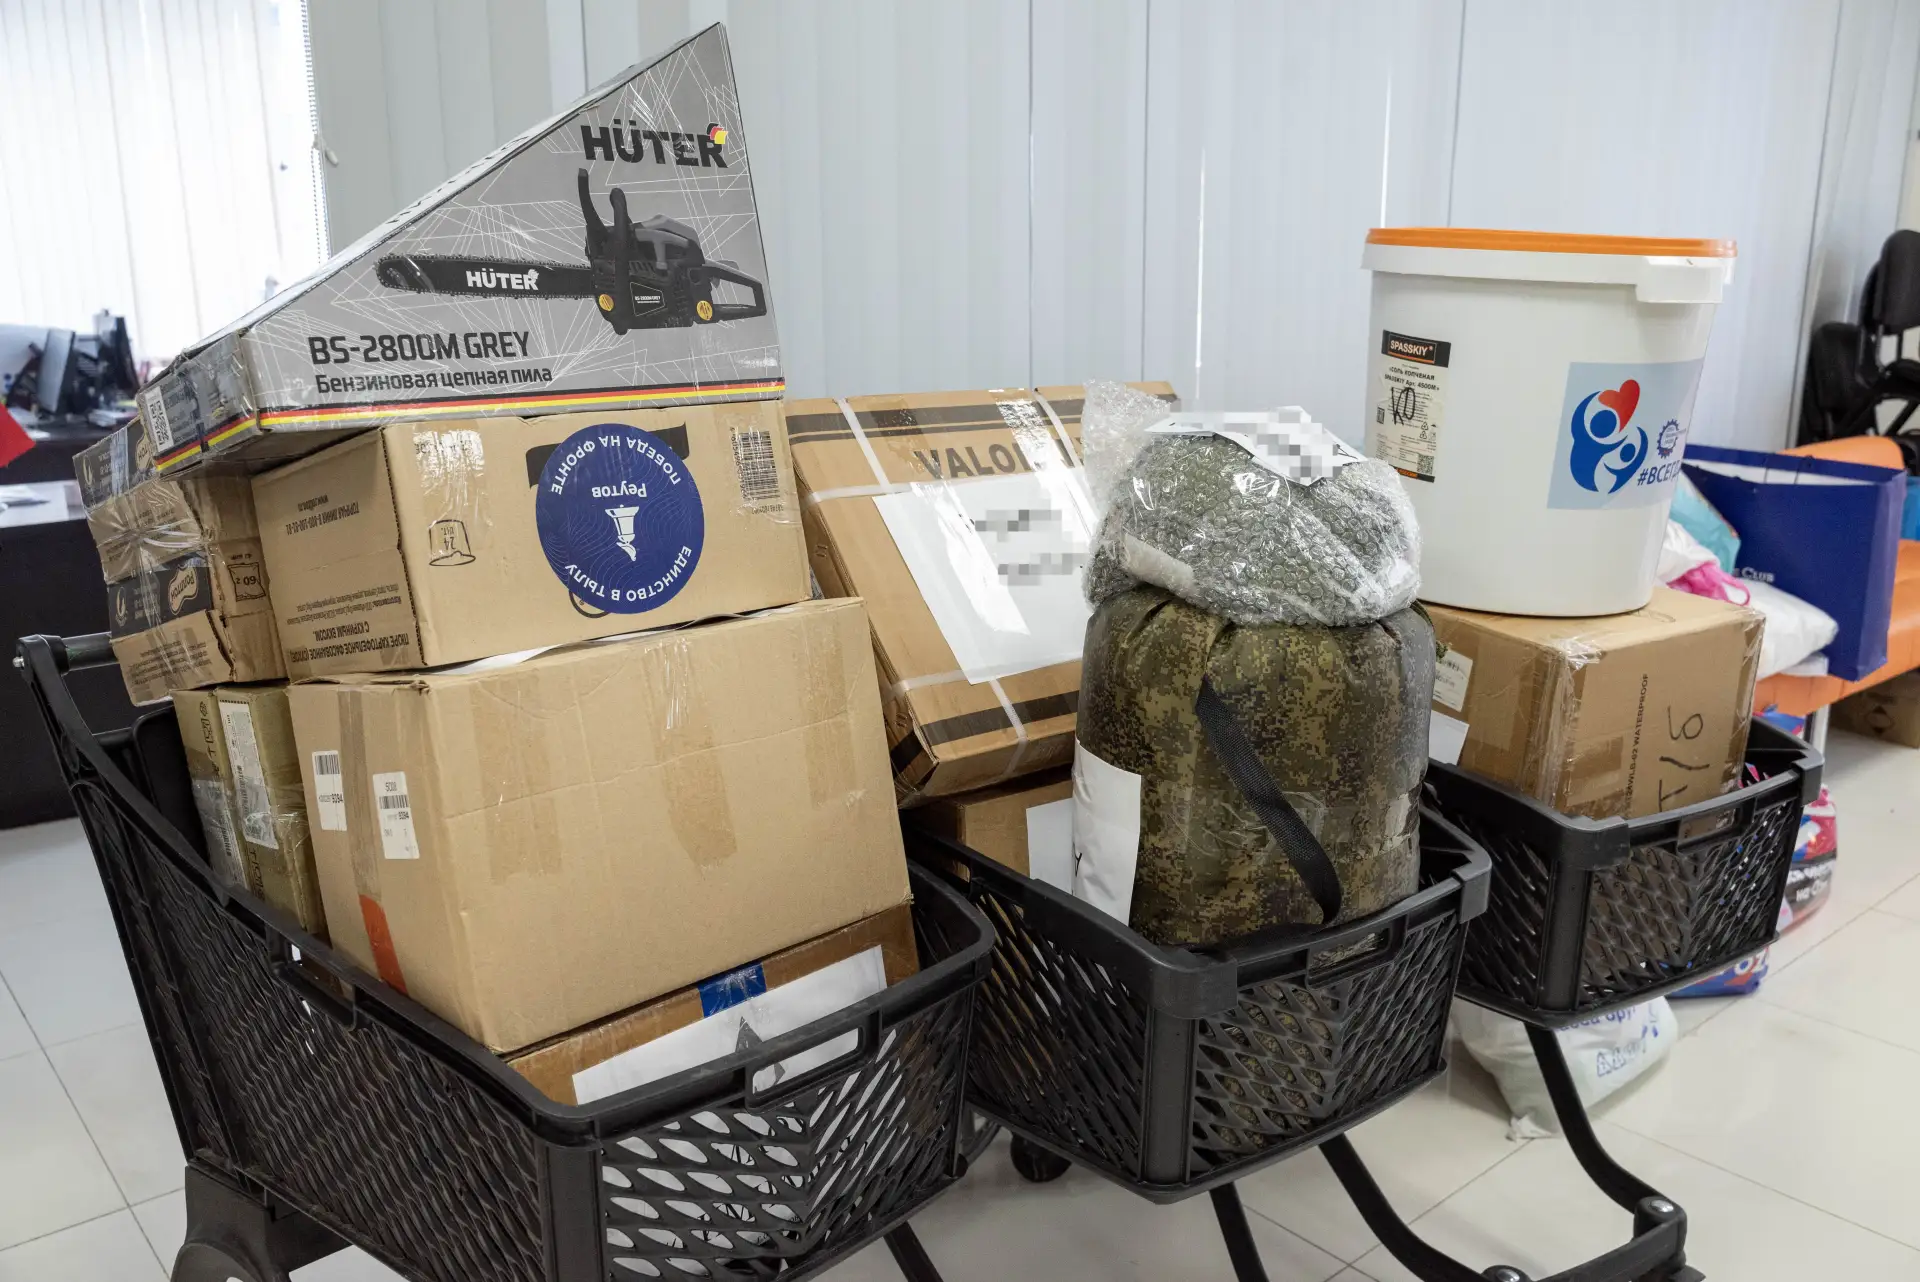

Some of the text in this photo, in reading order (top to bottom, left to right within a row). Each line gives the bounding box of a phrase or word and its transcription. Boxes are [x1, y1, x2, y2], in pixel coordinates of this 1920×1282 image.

[581, 119, 728, 169] HÜTER
[466, 267, 539, 292] HÜTER
[309, 331, 530, 366] BS-2800M GREY
[1390, 340, 1428, 357] SPASSKIY
[314, 367, 553, 394] Бензиновая цепная пила
[551, 435, 682, 495] ПОБЕДА НА ФРОНТЕ
[592, 480, 647, 498] Реутов
[443, 536, 456, 550] 24
[242, 574, 256, 585] 60
[565, 546, 692, 601] ЕДИНСТВО В ТЫЛУ
[337, 622, 365, 637] КУРИНЫМ
[345, 636, 390, 656] КАРТОФЕЛЬНОЕ
[390, 633, 410, 647] ПЮРЕ
[309, 643, 345, 661] ФАСОВАННОЕ
[1633, 673, 1648, 745] WATERPROOF
